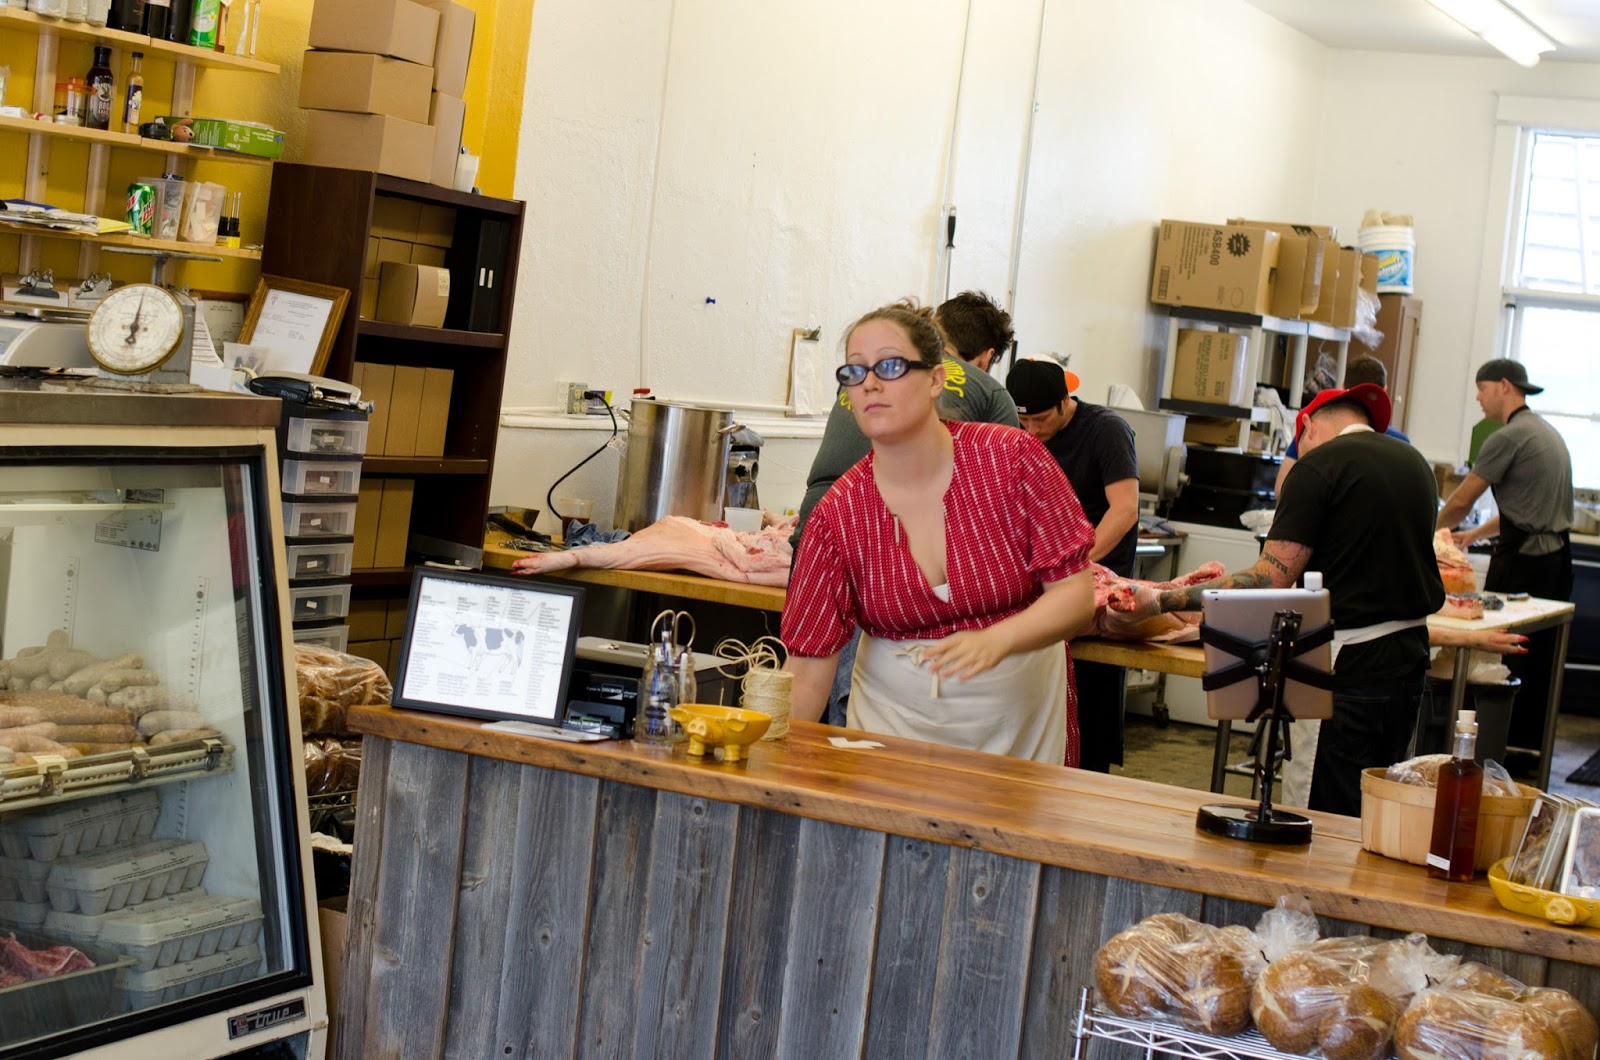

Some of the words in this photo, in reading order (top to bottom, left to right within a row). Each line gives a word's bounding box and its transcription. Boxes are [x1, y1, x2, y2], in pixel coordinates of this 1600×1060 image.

[1209, 229, 1223, 266] ASB400
[645, 727, 666, 737] VISA
[252, 1007, 296, 1029] true
